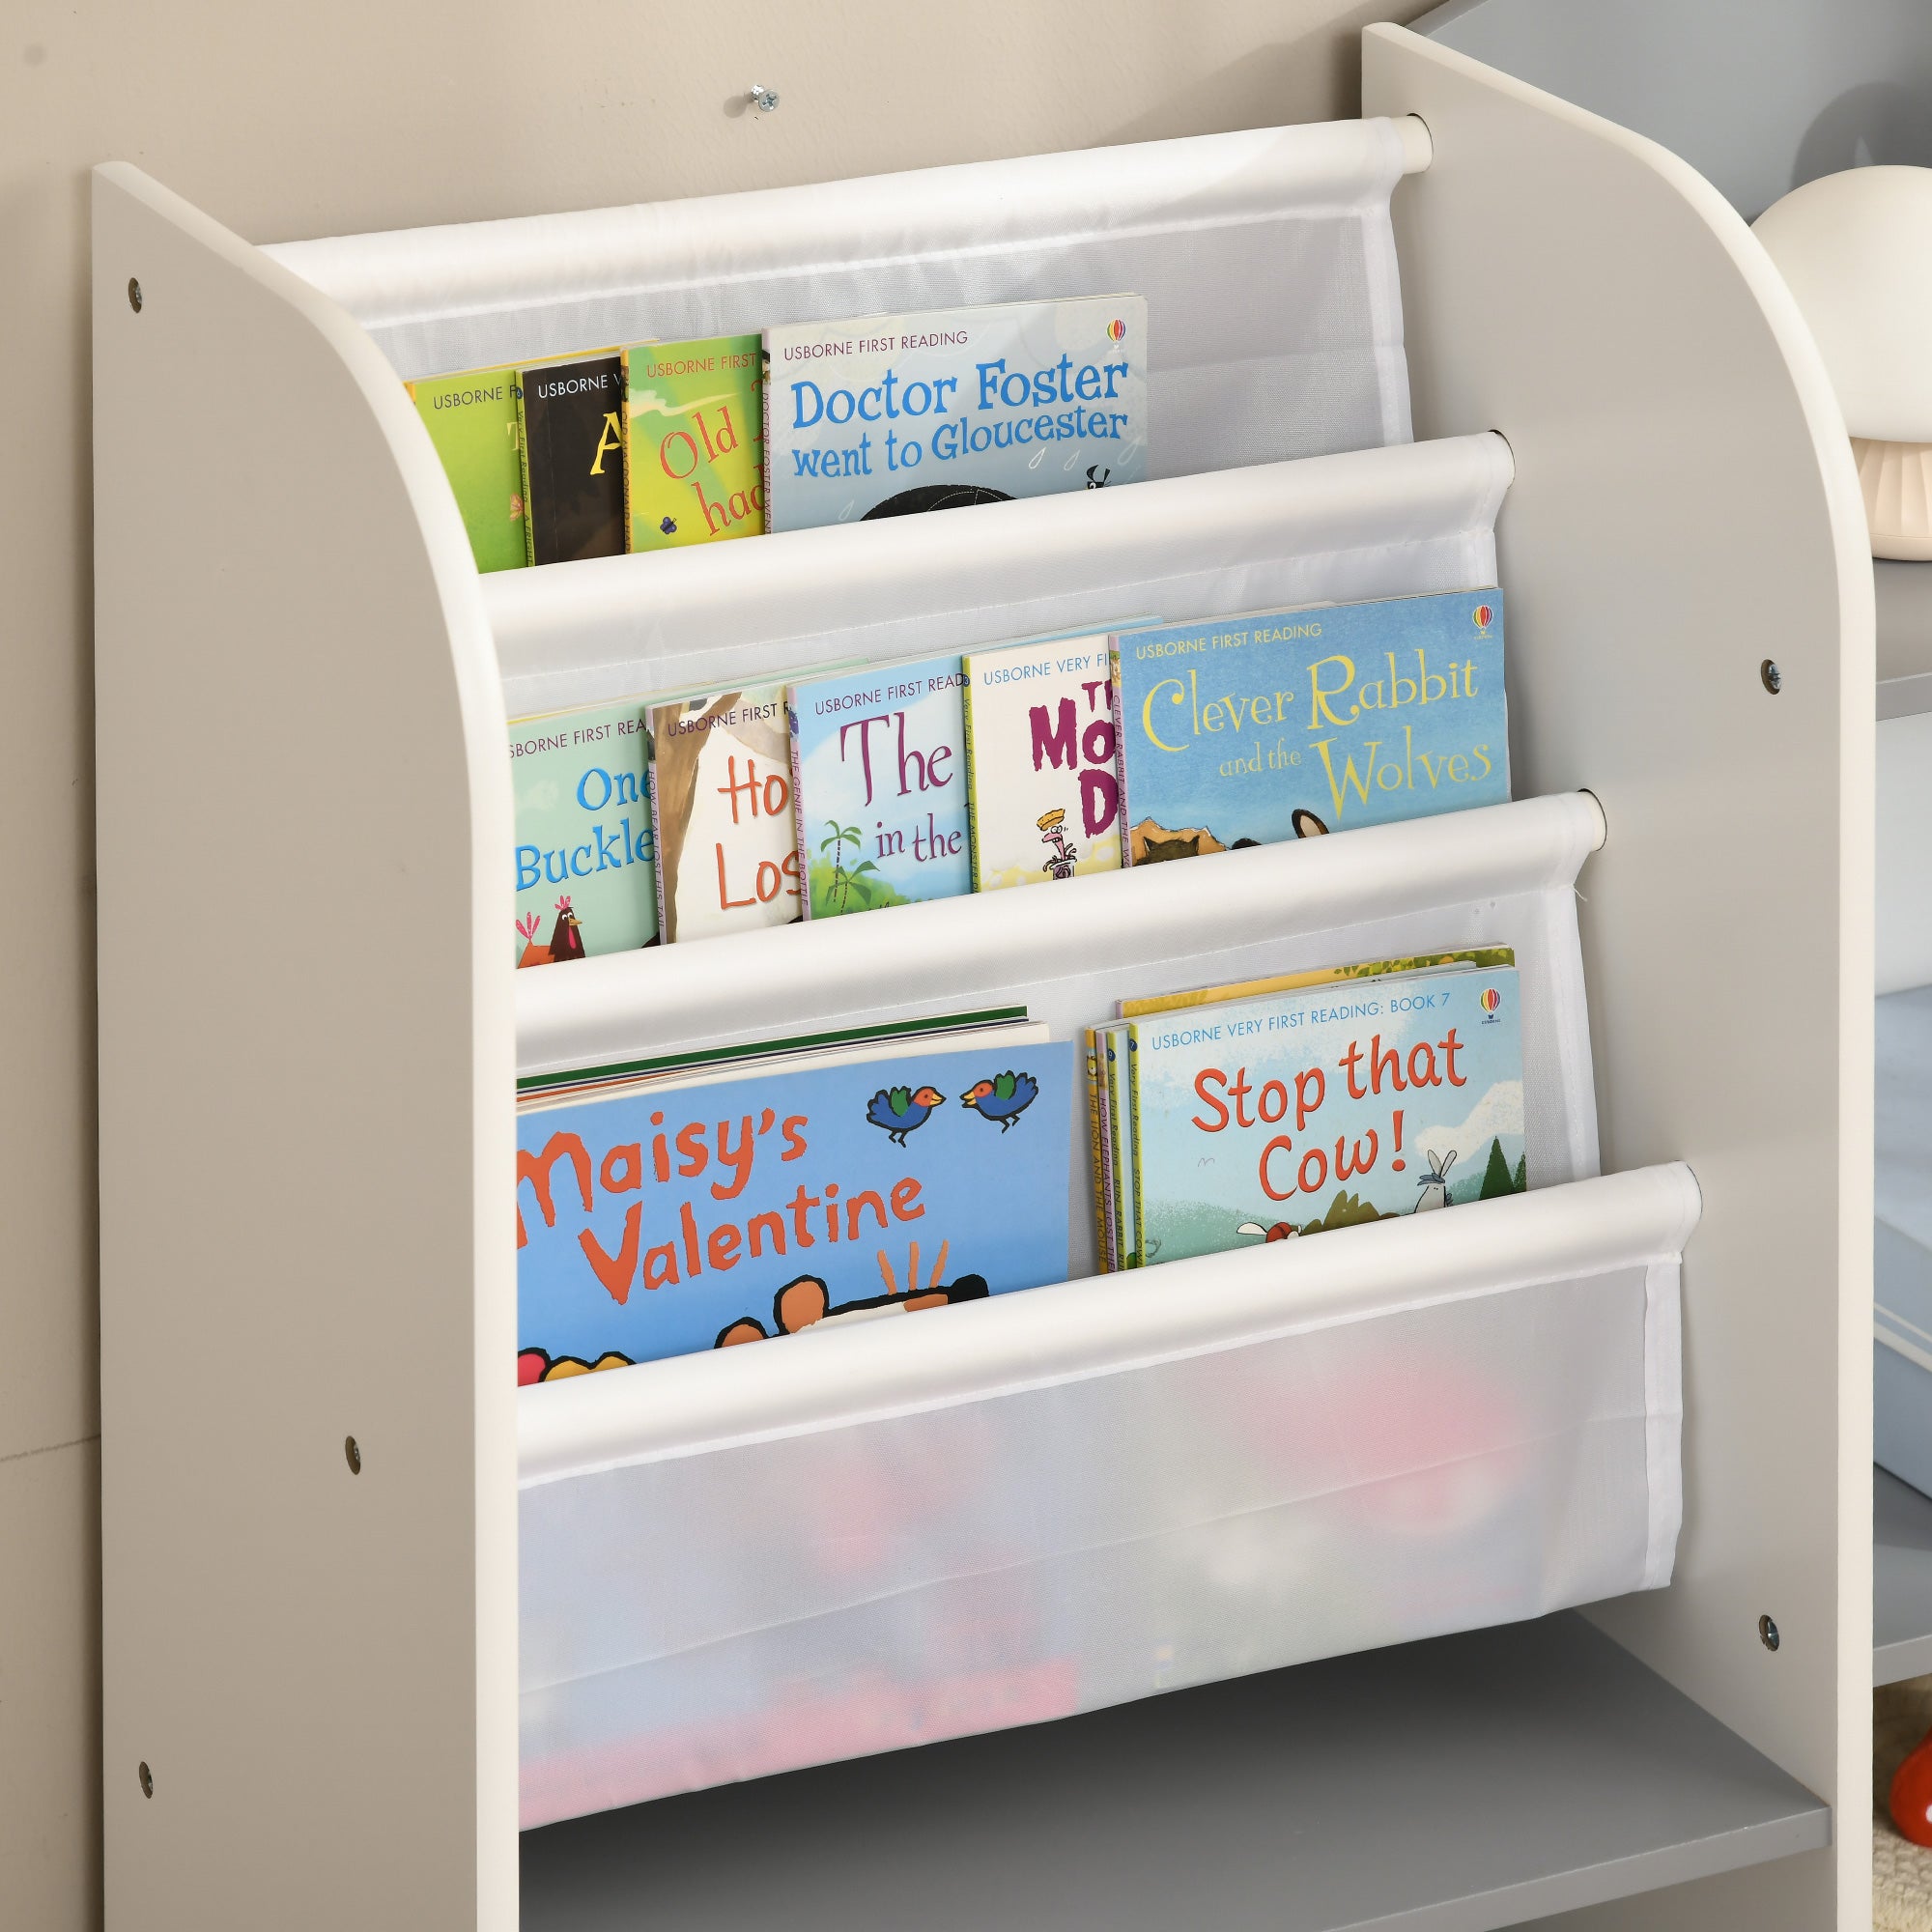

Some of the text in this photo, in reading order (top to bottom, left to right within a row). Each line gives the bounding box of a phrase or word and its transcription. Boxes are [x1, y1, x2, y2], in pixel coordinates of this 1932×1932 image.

[646, 354, 757, 379] USBORNE FIRST
[784, 330, 969, 360] USBORNE FIRST READING
[434, 387, 503, 411] USBORNE
[538, 375, 609, 399] USBORNE
[790, 368, 957, 429] Doctor
[975, 353, 1128, 411] Foster
[660, 406, 740, 480] Old
[792, 405, 1128, 478] went to Gloucester
[1136, 623, 1322, 660] USBORNE FIRST READING
[983, 662, 1052, 687] USBORNE
[1057, 656, 1092, 674] VERY
[668, 711, 737, 737] USBORNE
[742, 703, 779, 723] FIRST
[815, 689, 882, 715] USBORNE
[888, 681, 923, 700] FIRST
[1114, 695, 1122, 738] CLEVER
[1142, 648, 1480, 753] Clever Rabbit
[574, 724, 611, 745] FIRST
[839, 711, 953, 807] The
[1115, 743, 1125, 783] RABBIT
[1219, 725, 1492, 821] and the Wolves
[717, 755, 793, 824] Ho
[1119, 787, 1127, 816] AND
[651, 810, 660, 840] BEAR
[791, 750, 809, 907] THE GENIE IN THE BOTTLE
[876, 812, 962, 863] in the
[1121, 821, 1129, 843] THE
[515, 817, 654, 892] Buckle
[1151, 992, 1451, 1051] USBORNE VERY FIRST READING: BOOK 7
[1191, 1027, 1467, 1133] Stop that
[1132, 1115, 1141, 1156] Reading
[517, 1107, 809, 1250] Maisy's
[1089, 1094, 1106, 1262] THE LION AND THE MOUSE
[1102, 1137, 1112, 1207] ELEPHANTS
[578, 1177, 925, 1306] Valentine
[1105, 1210, 1114, 1242] LOST
